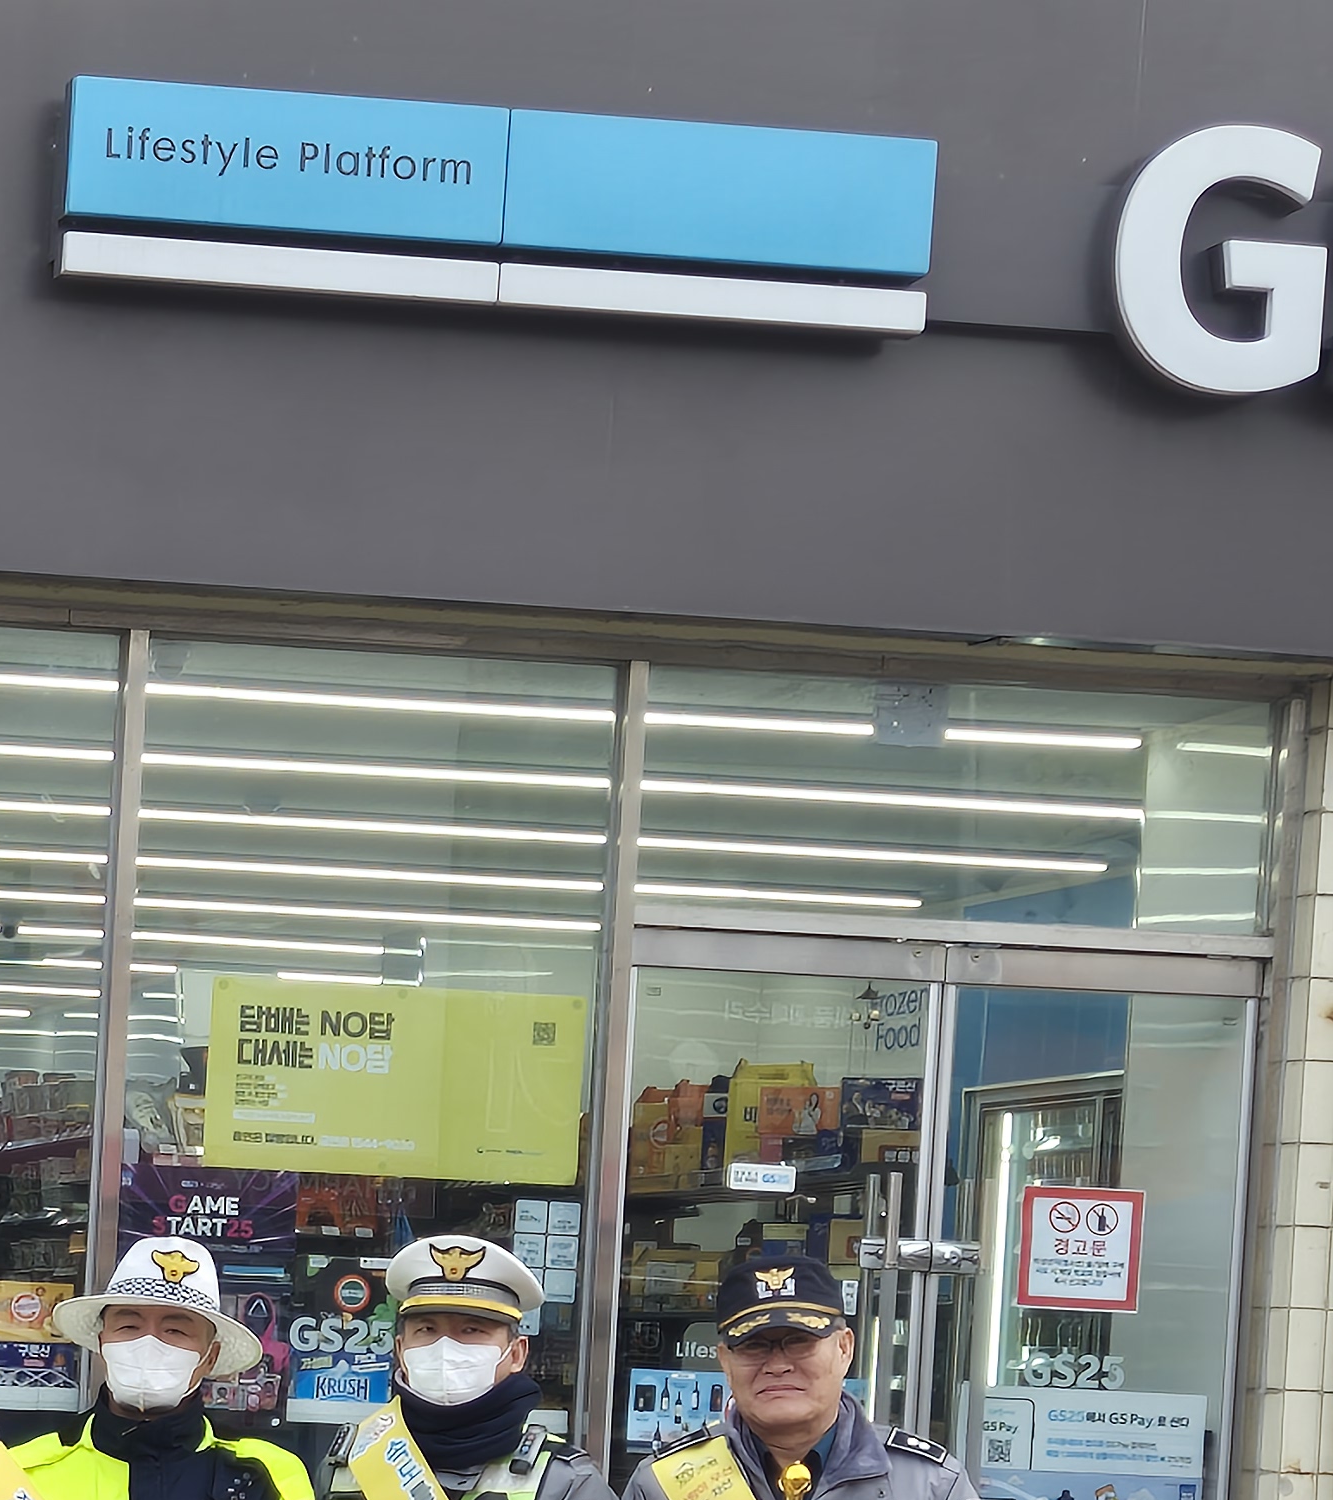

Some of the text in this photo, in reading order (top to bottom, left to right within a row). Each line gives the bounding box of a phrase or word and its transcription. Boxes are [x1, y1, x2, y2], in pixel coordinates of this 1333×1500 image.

[104, 125, 473, 186] Lifestyle Platform
[239, 1004, 395, 1041] 담배는 NO담
[874, 1021, 922, 1053] Food
[236, 1037, 314, 1070] 대세는
[168, 1193, 240, 1217] GAME
[1053, 1237, 1109, 1258] 경고문
[288, 1315, 395, 1356] GS25
[675, 1340, 718, 1360] Lifes
[1022, 1351, 1127, 1391] GS25
[315, 1375, 370, 1401] KRUSH
[1109, 1412, 1128, 1425] GS
[1130, 1413, 1154, 1429] Pay
